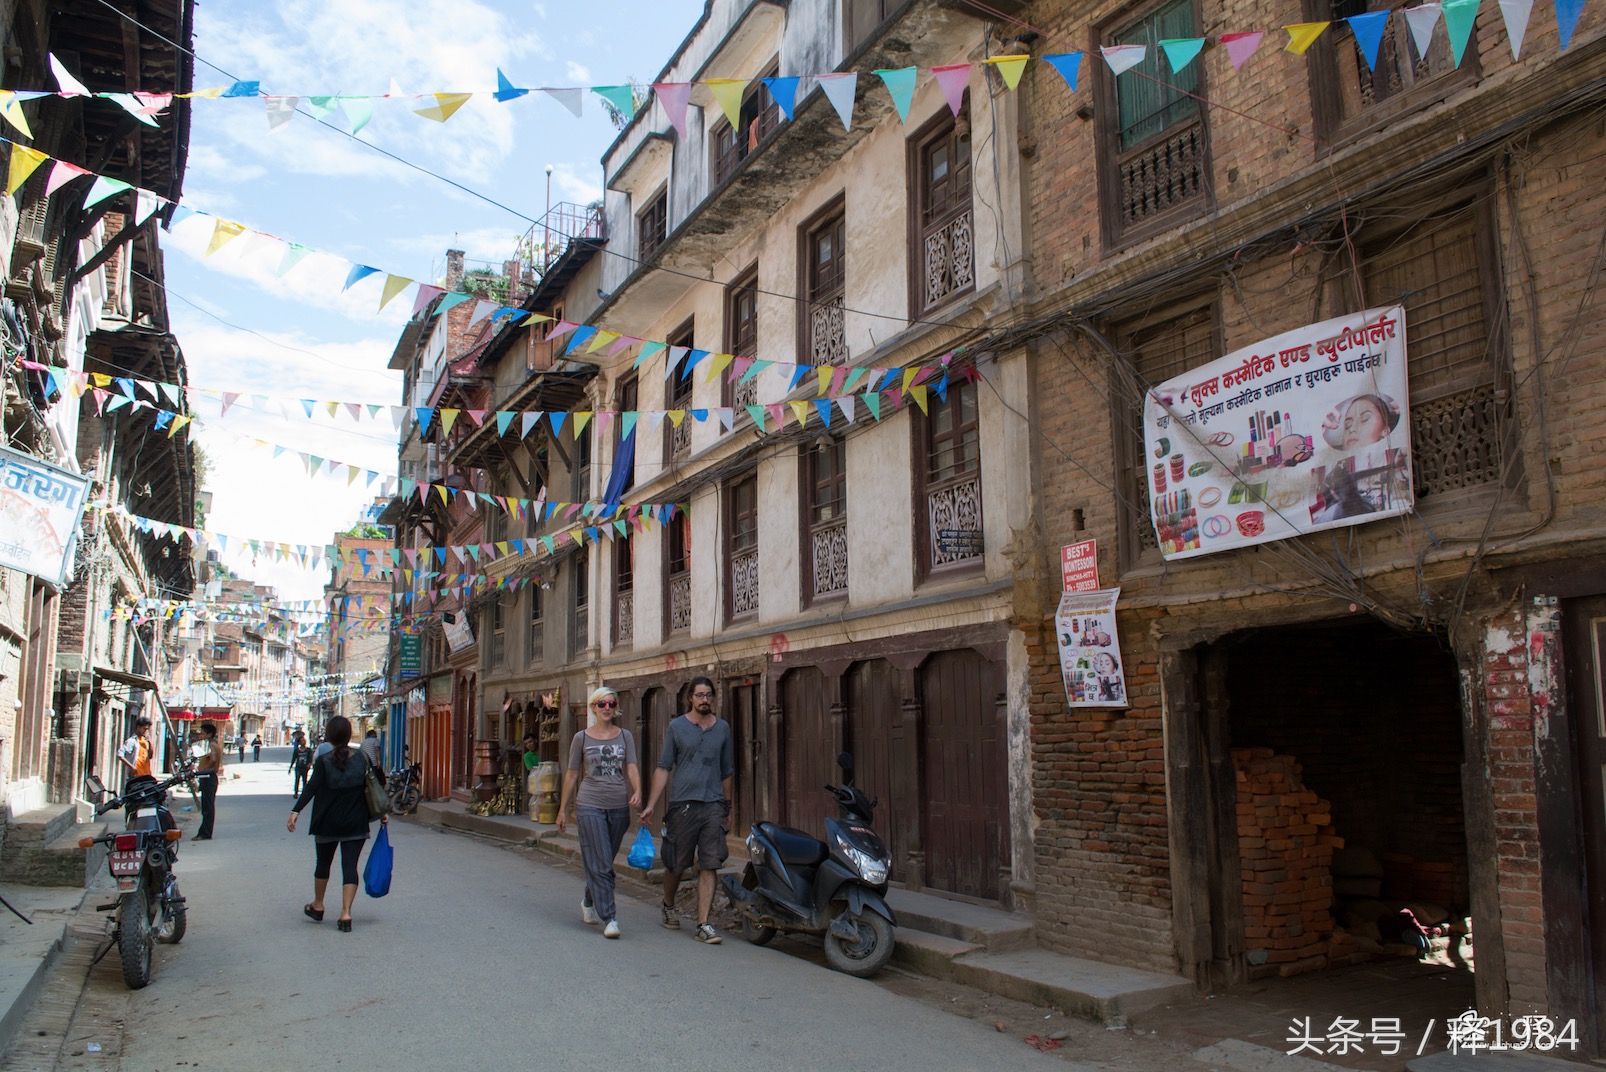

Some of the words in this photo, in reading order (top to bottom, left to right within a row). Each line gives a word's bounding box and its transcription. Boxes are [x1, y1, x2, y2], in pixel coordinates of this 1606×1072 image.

[1222, 354, 1275, 389] कस्मेटिक
[1279, 343, 1312, 368] एण्ड
[1226, 388, 1262, 411] कस्मेटिक
[1264, 377, 1292, 397] सामान
[1295, 374, 1302, 387] र
[1064, 556, 1095, 574] MONTESSORI
